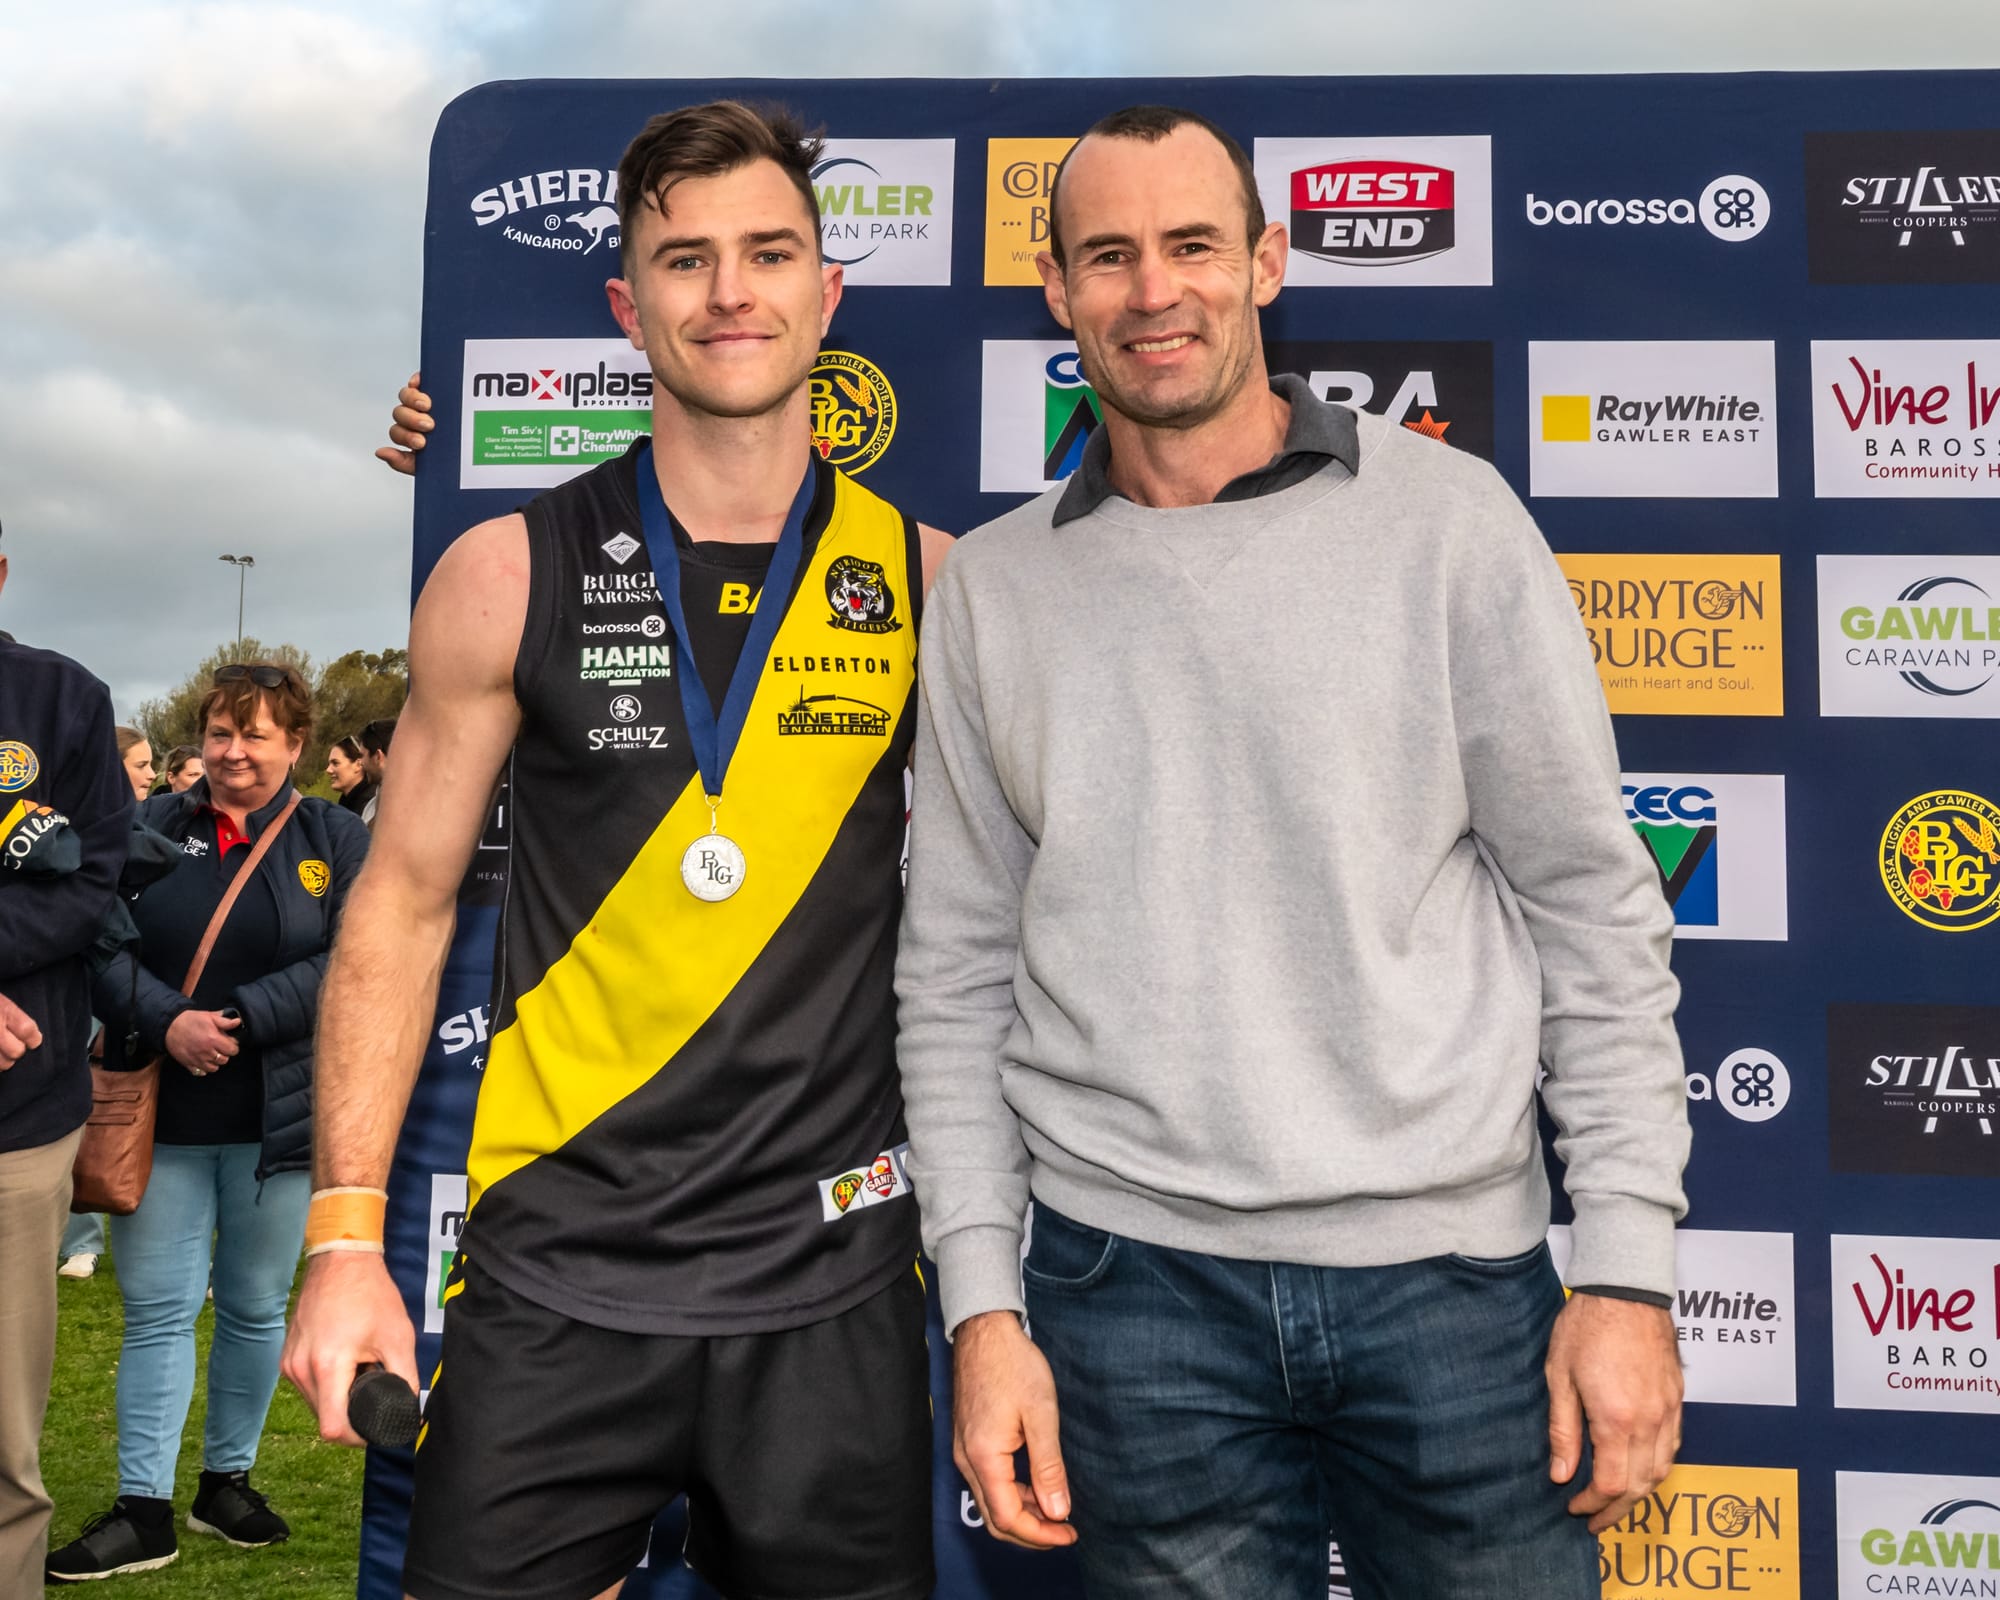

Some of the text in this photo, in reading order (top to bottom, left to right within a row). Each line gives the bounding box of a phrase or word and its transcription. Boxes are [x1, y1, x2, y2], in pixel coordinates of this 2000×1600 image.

[1305, 172, 1440, 202] WEST
[1526, 193, 1696, 226] barossa
[1892, 216, 1968, 227] COOPERS
[503, 226, 583, 250] KANGAROO
[871, 223, 929, 240] PARK
[1321, 218, 1426, 248] END
[820, 355, 865, 372] GAWLER
[865, 369, 893, 419] FOOTBALL
[1832, 356, 1950, 432] Vine
[583, 399, 629, 407] SPORTS
[501, 426, 519, 435] Tim
[1597, 429, 1760, 443] GAWLER EAST
[580, 441, 630, 453] Chemm
[1865, 438, 2000, 457] BAROS
[1865, 463, 1979, 482] Community
[583, 589, 664, 605] BAROSSA
[582, 623, 641, 635] barossa
[843, 618, 888, 632] TIGERS
[582, 645, 670, 669] HAHN
[774, 656, 891, 675] ELDERTON
[1845, 648, 1970, 667] CARAVAN
[580, 668, 671, 680] CORPORATION
[1608, 676, 1638, 689] with
[1643, 677, 1681, 690] Heart
[1686, 677, 1713, 690] and
[1718, 677, 1755, 691] Soul.
[588, 726, 669, 751] SCHULZ
[780, 725, 886, 735] ENGINEERING
[1886, 817, 1907, 850] LIGHT
[1906, 799, 1931, 820] AND
[1935, 795, 1986, 814] GAWLER
[477, 871, 507, 881] HEAL
[1918, 1101, 1996, 1114] COOPERS
[1852, 1253, 1976, 1337] Vine
[1717, 1328, 1777, 1345] EAST
[1887, 1345, 1988, 1368] BARO
[1866, 1574, 1997, 1598] CARAVAN
